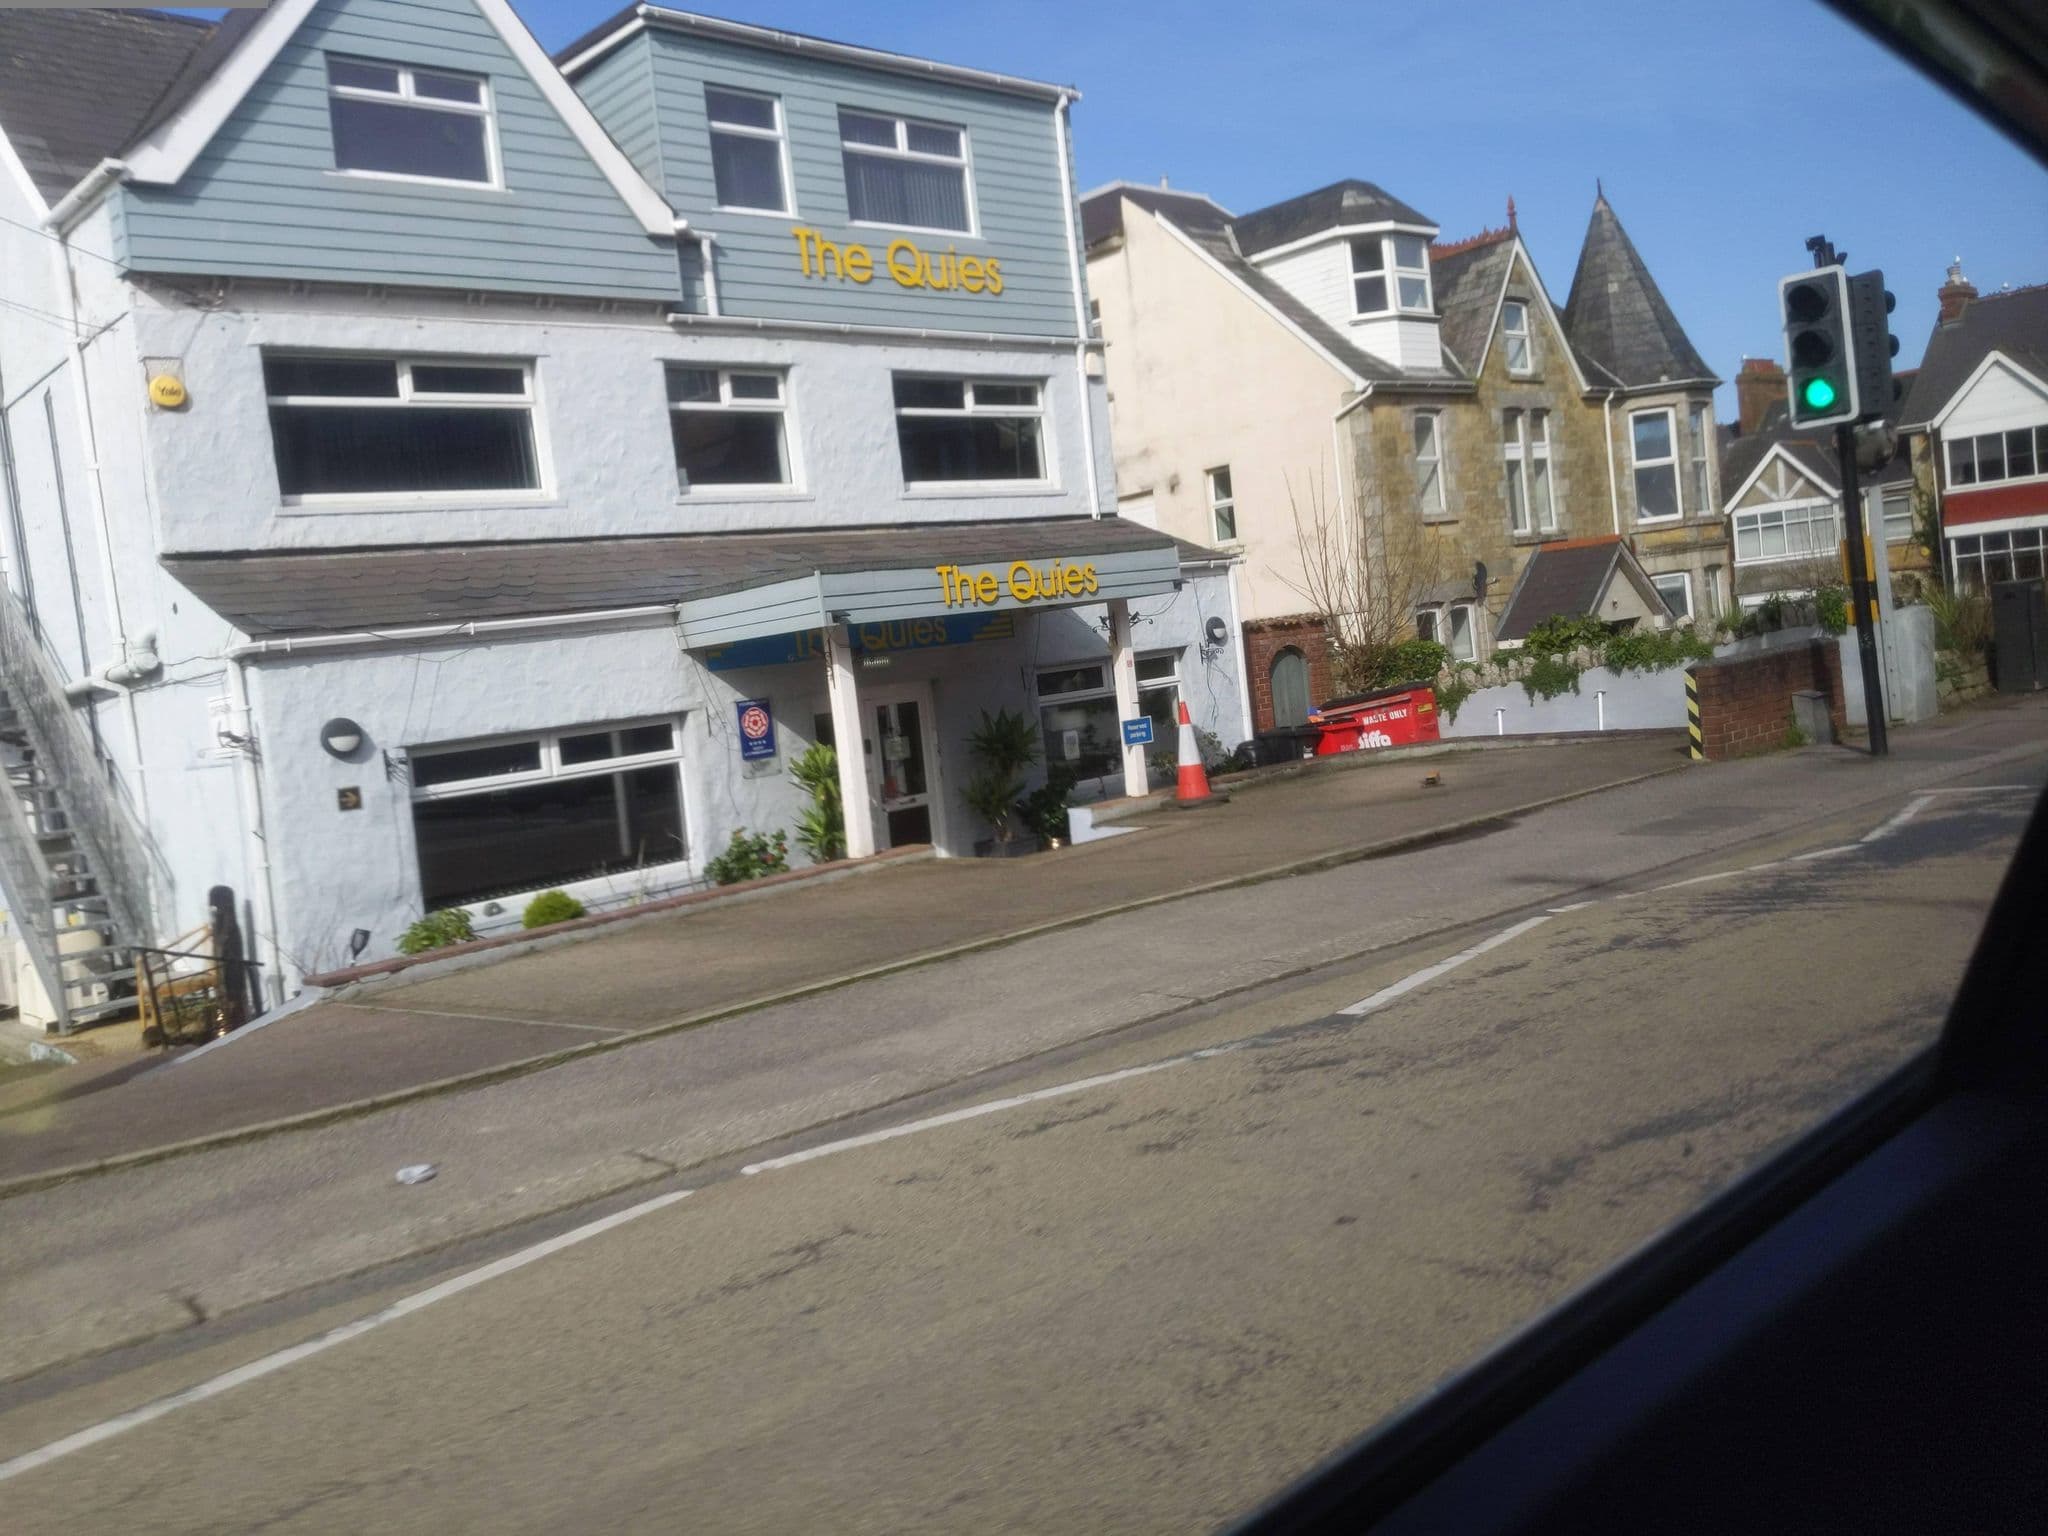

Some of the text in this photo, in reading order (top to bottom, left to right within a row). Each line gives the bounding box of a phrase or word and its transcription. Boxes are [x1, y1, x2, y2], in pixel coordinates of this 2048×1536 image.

[791, 226, 1004, 295] The Quies
[935, 558, 1099, 608] The Quies
[1362, 712, 1387, 726] WASTE
[1389, 708, 1408, 720] ONLY
